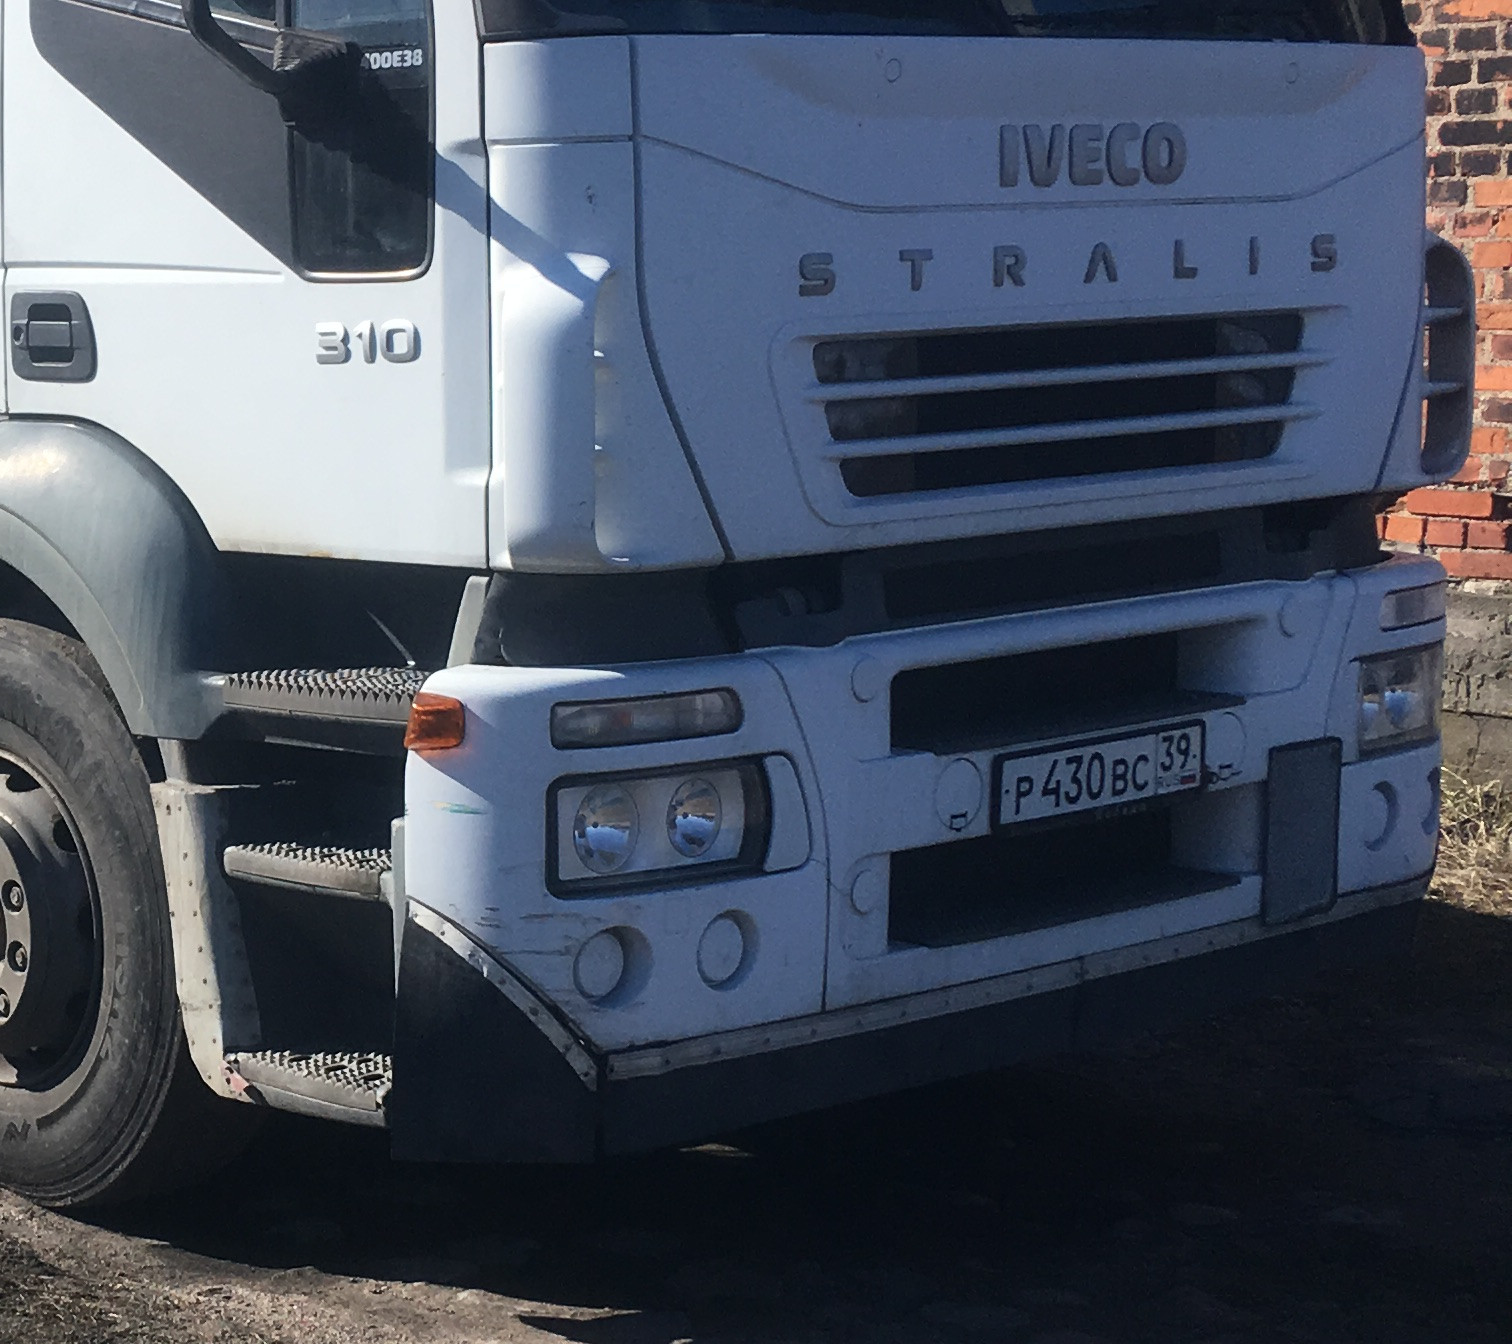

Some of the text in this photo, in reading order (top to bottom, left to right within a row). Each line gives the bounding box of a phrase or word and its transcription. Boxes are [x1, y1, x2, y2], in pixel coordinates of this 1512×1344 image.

[999, 122, 1186, 187] IVECO
[798, 233, 1339, 297] STRALIS
[314, 318, 421, 365] 310
